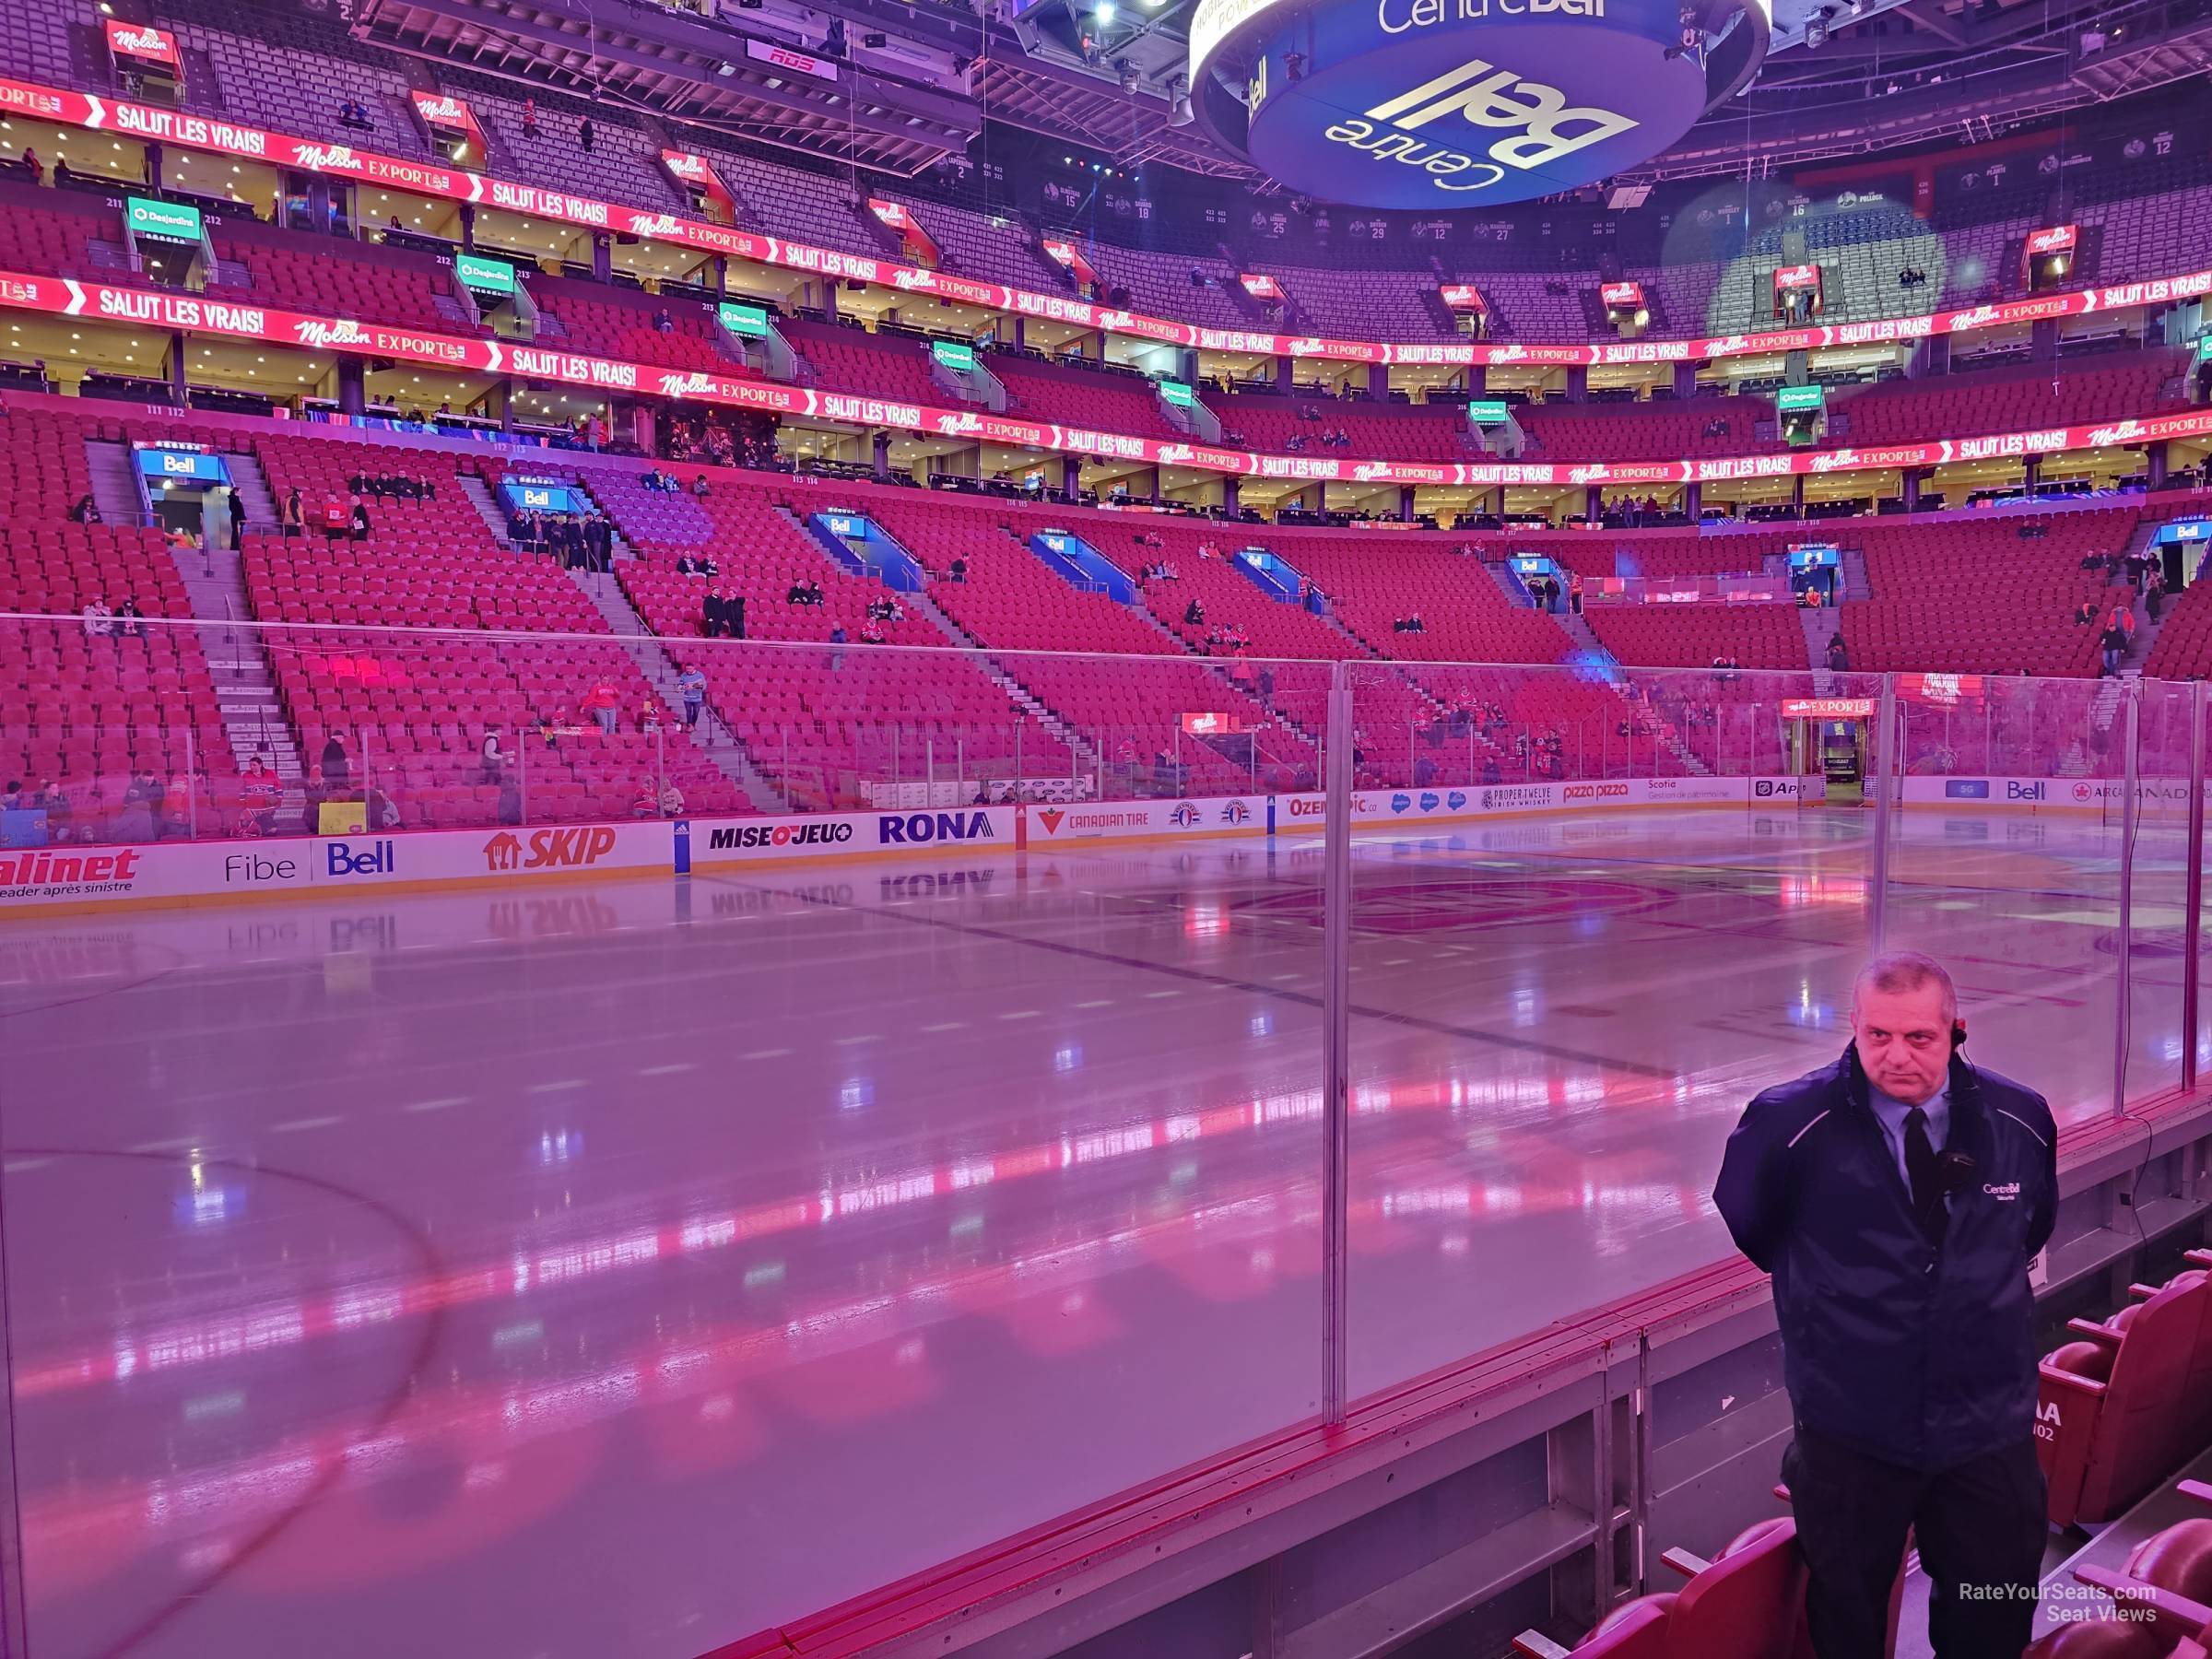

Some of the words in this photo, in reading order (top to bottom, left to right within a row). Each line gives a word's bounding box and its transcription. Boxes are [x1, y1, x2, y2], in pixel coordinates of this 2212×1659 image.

[112, 29, 167, 52] Molson
[769, 48, 817, 72] RDS
[1248, 54, 1267, 118] Bell
[417, 99, 462, 119] Molson
[1364, 59, 1641, 170] Bell
[117, 105, 172, 136] SALUT
[175, 117, 206, 144] LES
[211, 124, 265, 156] VRAIS!
[1324, 120, 1505, 191] Centre
[2156, 141, 2171, 155] 12
[292, 144, 363, 171] Molson
[369, 160, 430, 186] EXPORT
[665, 158, 703, 174] Molson
[959, 166, 965, 179] 2
[106, 198, 123, 209] 211
[493, 185, 535, 208] SALUT
[538, 194, 563, 215] LES
[565, 200, 607, 224] VRAIS!
[1065, 194, 1076, 207] 15
[149, 210, 194, 228] Desjardins
[1138, 207, 1149, 218] 18
[1793, 204, 1805, 217] 16
[205, 215, 222, 227] 212
[629, 214, 685, 238] Molson
[688, 227, 736, 247] EXPORT
[1273, 222, 1285, 234] 25
[1371, 228, 1384, 239] 29
[1435, 229, 1445, 240] 12
[1497, 229, 1508, 241] 27
[2034, 232, 2071, 247] Molson
[436, 255, 452, 266] 212
[785, 245, 819, 266] SALUT
[822, 253, 841, 272] LES
[843, 256, 877, 279] VRAIS!
[473, 266, 510, 281] Desjardins
[516, 269, 530, 280] 213
[1779, 270, 1813, 284] Molson
[893, 269, 937, 289] Molson
[940, 279, 979, 298] EXPORT
[2104, 287, 2144, 307] SALUT
[2145, 282, 2169, 300] LES
[2171, 273, 2212, 295] VRAIS!
[1604, 287, 1635, 300] Molson
[100, 289, 160, 320] SALUT
[166, 300, 200, 325] LES
[204, 305, 265, 335] VRAIS!
[702, 302, 714, 312] 213
[1018, 295, 1045, 313] SALUT
[1048, 301, 1062, 316] LES
[1064, 303, 1091, 323] VRAIS!
[1949, 306, 2000, 331] Molson
[2004, 302, 2052, 320] EXPORT
[1099, 311, 1135, 329] Molson
[1137, 320, 1171, 336] EXPORT
[1840, 324, 1873, 342] SALUT
[1875, 322, 1895, 338] LES
[1898, 316, 1933, 335] VRAIS!
[293, 321, 371, 347] Molson
[378, 334, 446, 355] EXPORT
[1201, 330, 1226, 347] SALUT
[1228, 333, 1244, 349] LES
[1245, 335, 1274, 352] VRAIS!
[1705, 335, 1748, 357] Molson
[1752, 334, 1795, 349] EXPORT
[1288, 339, 1324, 358] Molson
[1328, 345, 1362, 359] EXPORT
[1397, 347, 1425, 362] SALUT
[1427, 347, 1443, 362] LES
[1445, 346, 1475, 362] VRAIS!
[1488, 345, 1528, 364] Molson
[1531, 349, 1568, 360] EXPORT
[1606, 346, 1637, 363] SALUT
[1638, 345, 1657, 360] LES
[1659, 342, 1688, 359] VRAIS!
[513, 352, 557, 376] SALUT
[562, 357, 588, 381] LES
[591, 362, 637, 386] VRAIS!
[658, 373, 718, 397] Molson
[723, 383, 775, 405] EXPORT
[147, 405, 162, 416] 111
[168, 406, 185, 418] 112
[825, 396, 860, 417] SALUT
[862, 401, 884, 420] LES
[886, 405, 920, 427] VRAIS!
[937, 415, 983, 436] Molson
[987, 422, 1028, 440] EXPORT
[2088, 420, 2147, 441] Molson
[2150, 416, 2206, 437] EXPORT
[1068, 432, 1096, 450] SALUT
[1098, 435, 1114, 453] LES
[1116, 439, 1144, 457] VRAIS!
[1960, 441, 1999, 458] SALUT
[2001, 438, 2024, 454] LES
[2026, 431, 2067, 450] VRAIS!
[163, 455, 194, 474] Bell
[1157, 445, 1194, 464] Molson
[1197, 452, 1231, 466] EXPORT
[1809, 450, 1860, 472] Molson
[1864, 451, 1911, 465] EXPORT
[1263, 460, 1289, 475] SALUT
[1290, 461, 1309, 476] LES
[1310, 462, 1339, 477] VRAIS!
[1354, 463, 1393, 480] Molson
[1395, 468, 1431, 479] EXPORT
[1472, 465, 1500, 482] SALUT
[1501, 465, 1521, 481] LES
[1523, 465, 1553, 480] VRAIS!
[1569, 465, 1611, 484] Molson
[1614, 467, 1657, 480] EXPORT
[1699, 462, 1732, 478] SALUT
[1734, 460, 1755, 476] LES
[1756, 457, 1792, 474] VRAIS!
[525, 489, 549, 506] Bell
[831, 518, 850, 533] Bell
[2177, 525, 2199, 537] Bell
[1522, 560, 1537, 571] Bell
[1811, 700, 1858, 712] EXPORT
[1494, 789, 1521, 800] PROPER
[1524, 787, 1551, 799] TWELVE
[1563, 784, 1594, 803] pizza
[1595, 783, 1629, 801] pizza
[1648, 780, 1677, 790] Scotia
[1960, 785, 1974, 794] 5G
[2007, 781, 2046, 800] Bell
[1648, 791, 1675, 800] Gestion
[878, 812, 994, 844] RONA
[1069, 812, 1124, 829] CANADIAN
[1125, 812, 1148, 826] TIRE
[524, 827, 617, 869] SKIP
[225, 853, 297, 882] Fibe
[327, 840, 394, 877] Bell
[43, 882, 81, 898] après
[84, 881, 133, 893] sinistre
[2033, 1423, 2054, 1441] 102
